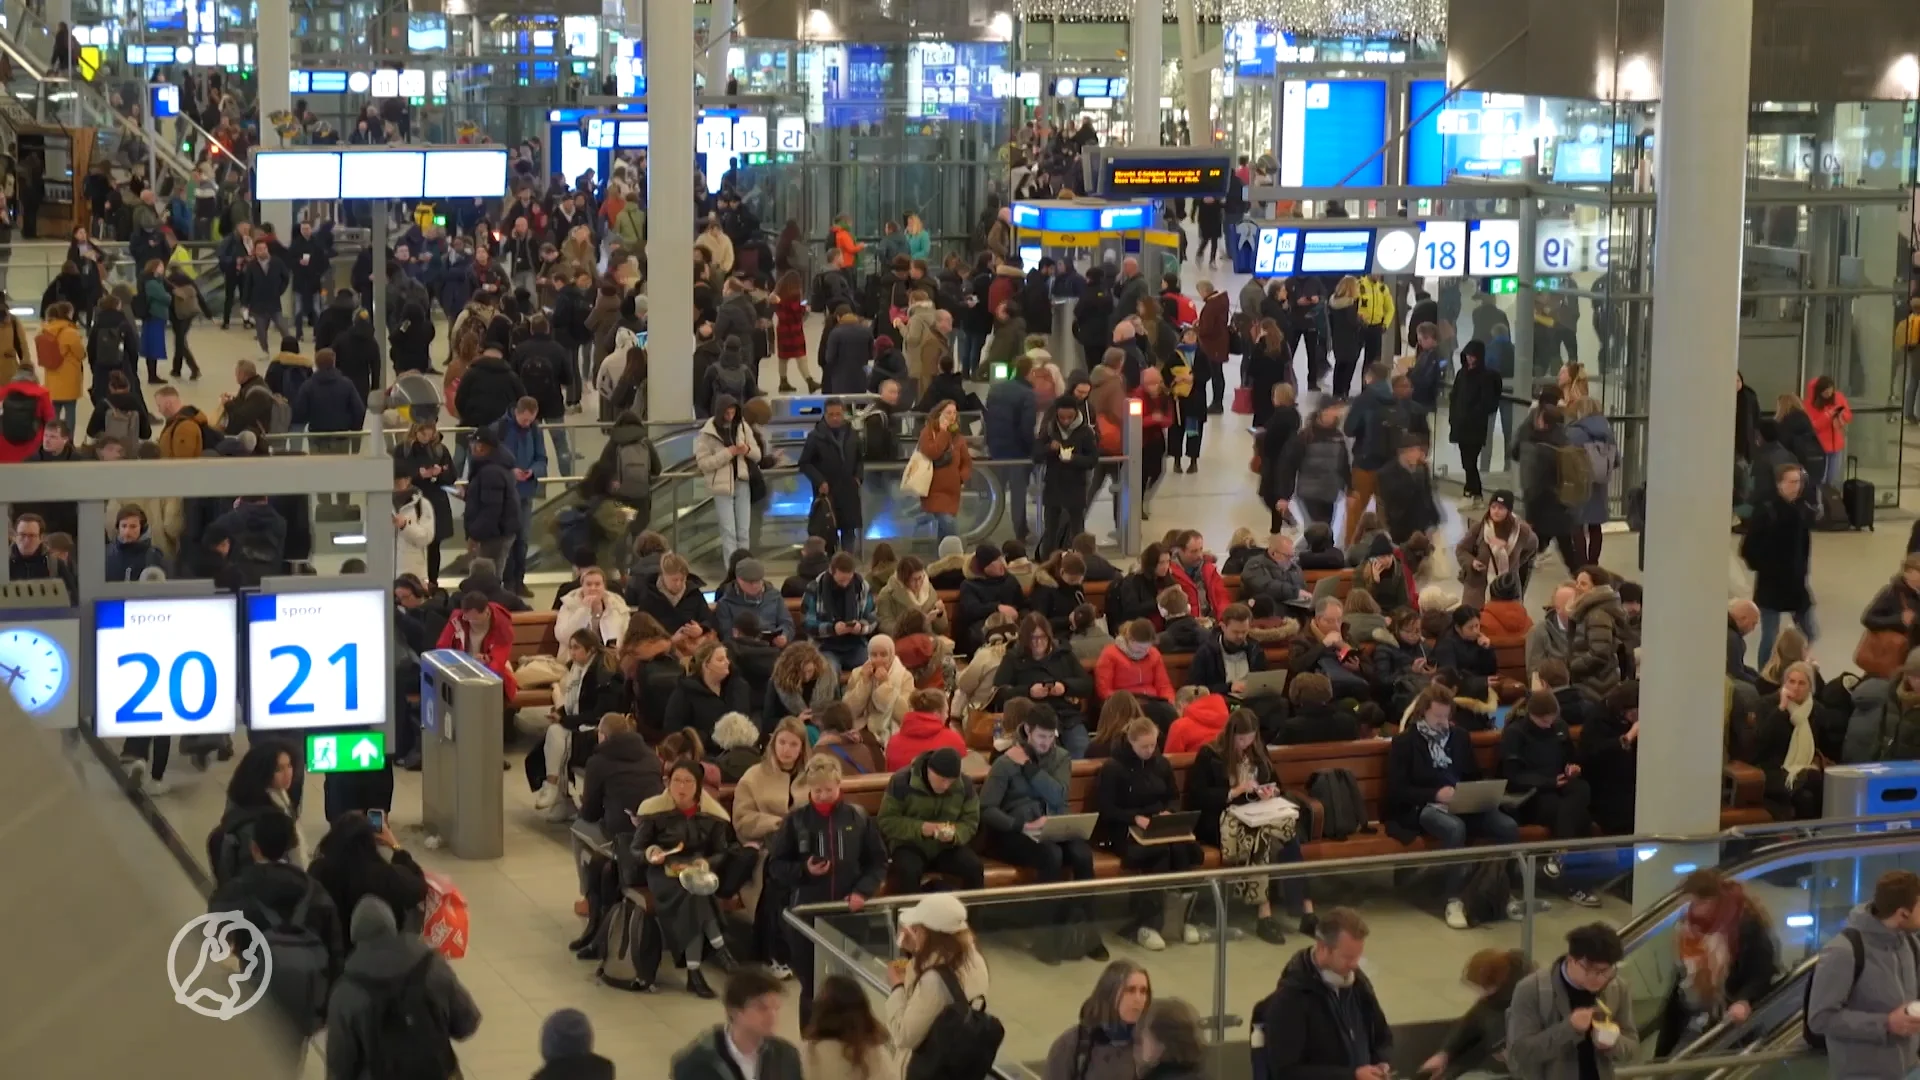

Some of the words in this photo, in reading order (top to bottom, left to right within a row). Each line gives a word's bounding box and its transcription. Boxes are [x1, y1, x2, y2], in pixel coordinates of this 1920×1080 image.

[743, 130, 760, 148] 15
[1425, 241, 1456, 270] 18
[1479, 239, 1510, 268] 19
[130, 613, 172, 625] spoor
[282, 605, 322, 617] spoor
[116, 650, 217, 723] 20
[269, 643, 358, 715] 21
